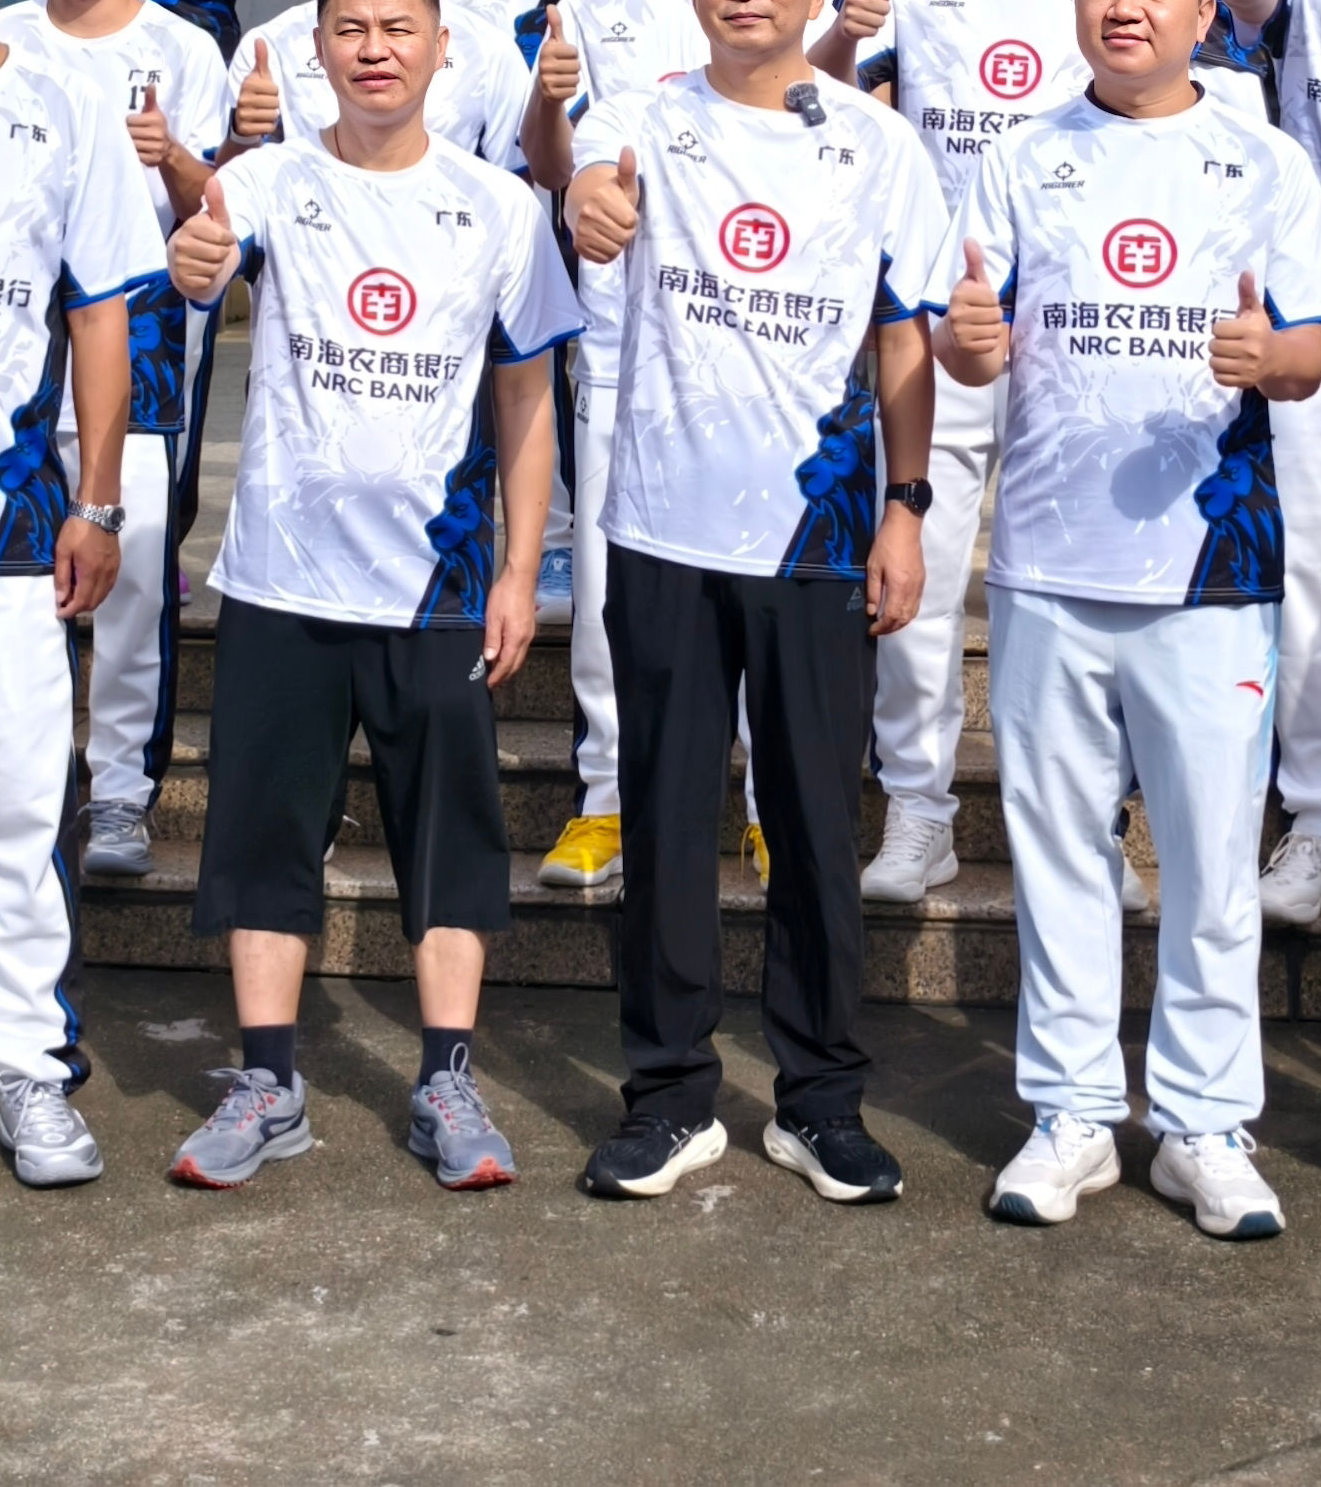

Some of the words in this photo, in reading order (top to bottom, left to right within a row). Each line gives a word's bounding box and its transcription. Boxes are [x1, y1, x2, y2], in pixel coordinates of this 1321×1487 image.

[128, 69, 161, 84] 广东
[9, 124, 48, 144] 广东
[817, 145, 856, 166] 广东
[1203, 160, 1245, 179] 广东
[435, 210, 473, 228] 广东
[685, 302, 738, 330] NRC
[1069, 335, 1121, 357] NRC
[1128, 336, 1205, 361] BANK
[311, 369, 365, 396] NRC
[369, 380, 439, 404] BANK
